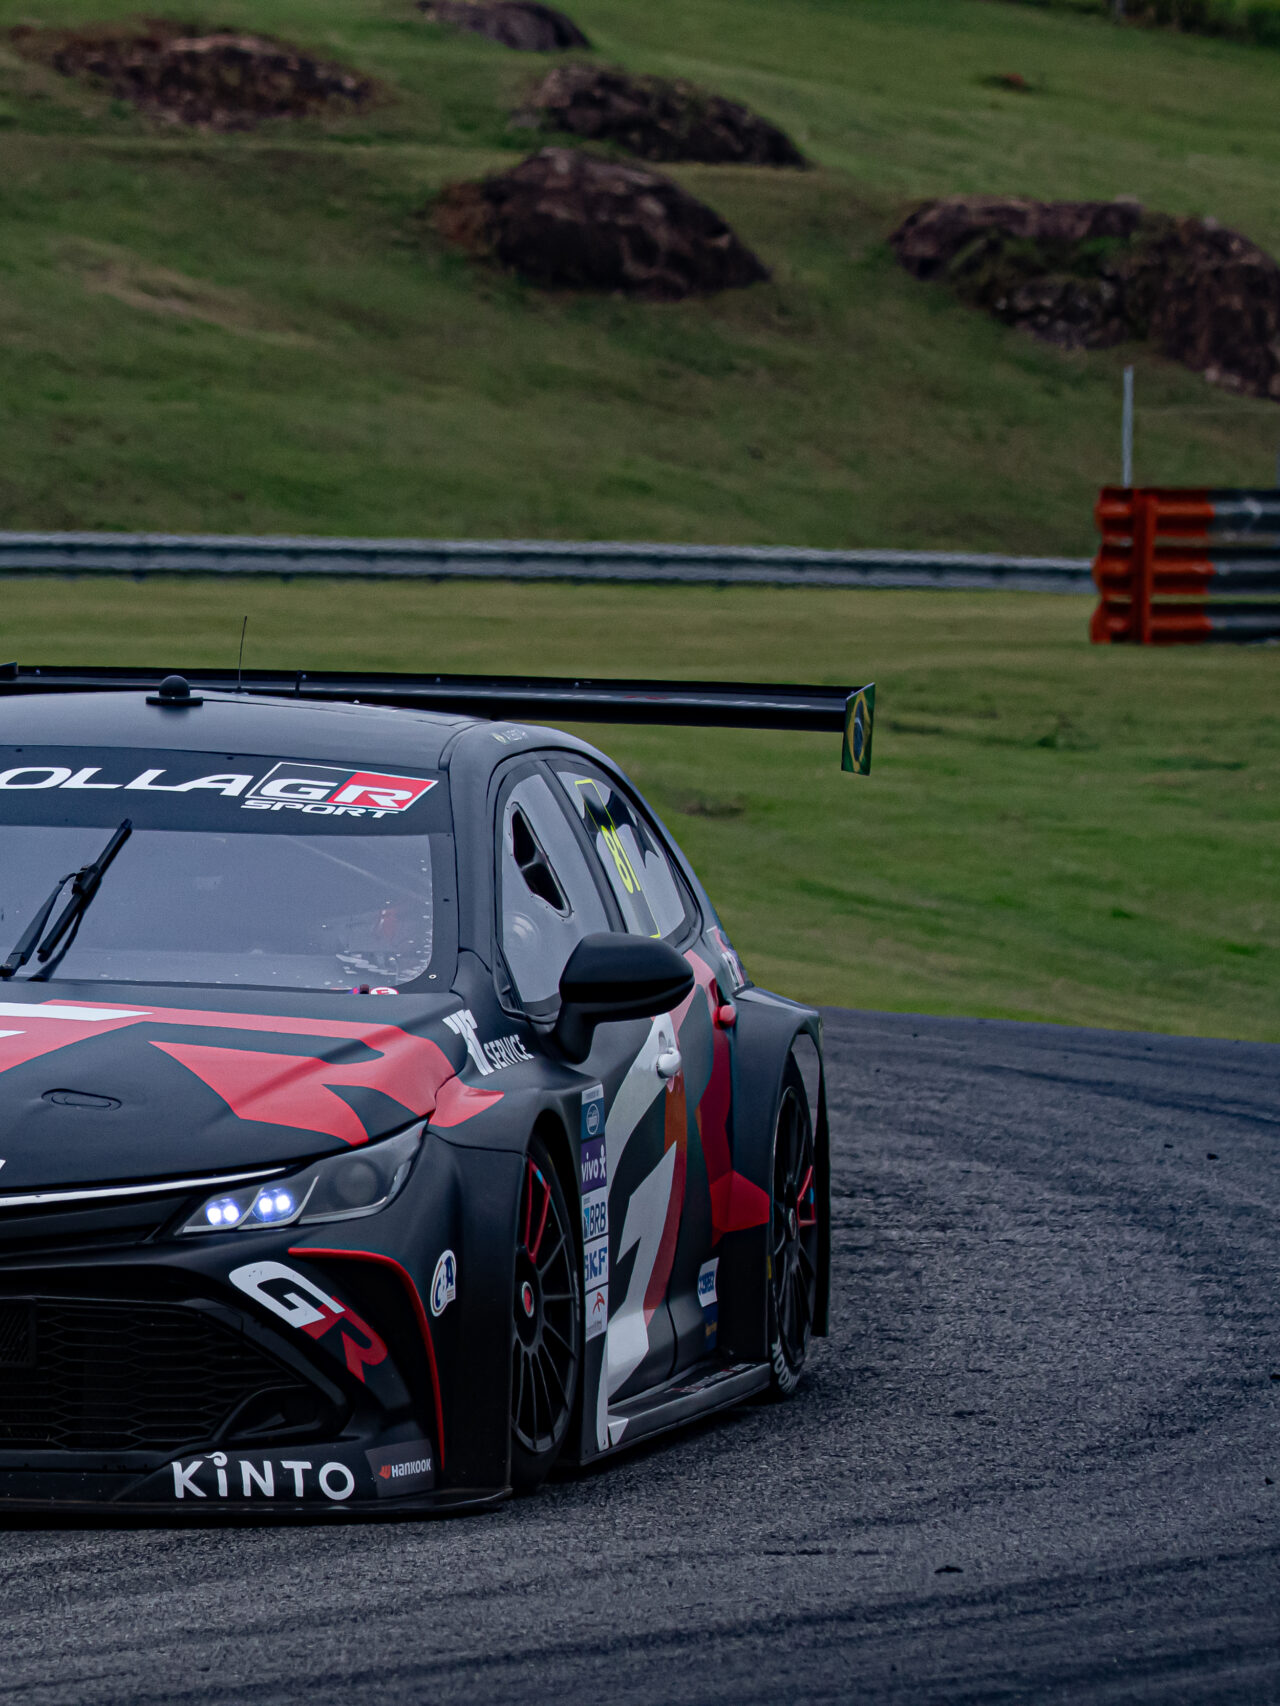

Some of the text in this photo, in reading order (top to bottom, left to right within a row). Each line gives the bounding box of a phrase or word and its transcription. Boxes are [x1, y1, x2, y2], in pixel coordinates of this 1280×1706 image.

[241, 800, 399, 819] SPORT
[260, 778, 413, 808] GR
[600, 825, 641, 894] 81
[483, 1034, 536, 1070] SERVICE
[581, 1151, 599, 1183] vivo
[589, 1201, 606, 1236] BRB
[228, 1261, 388, 1384] GR
